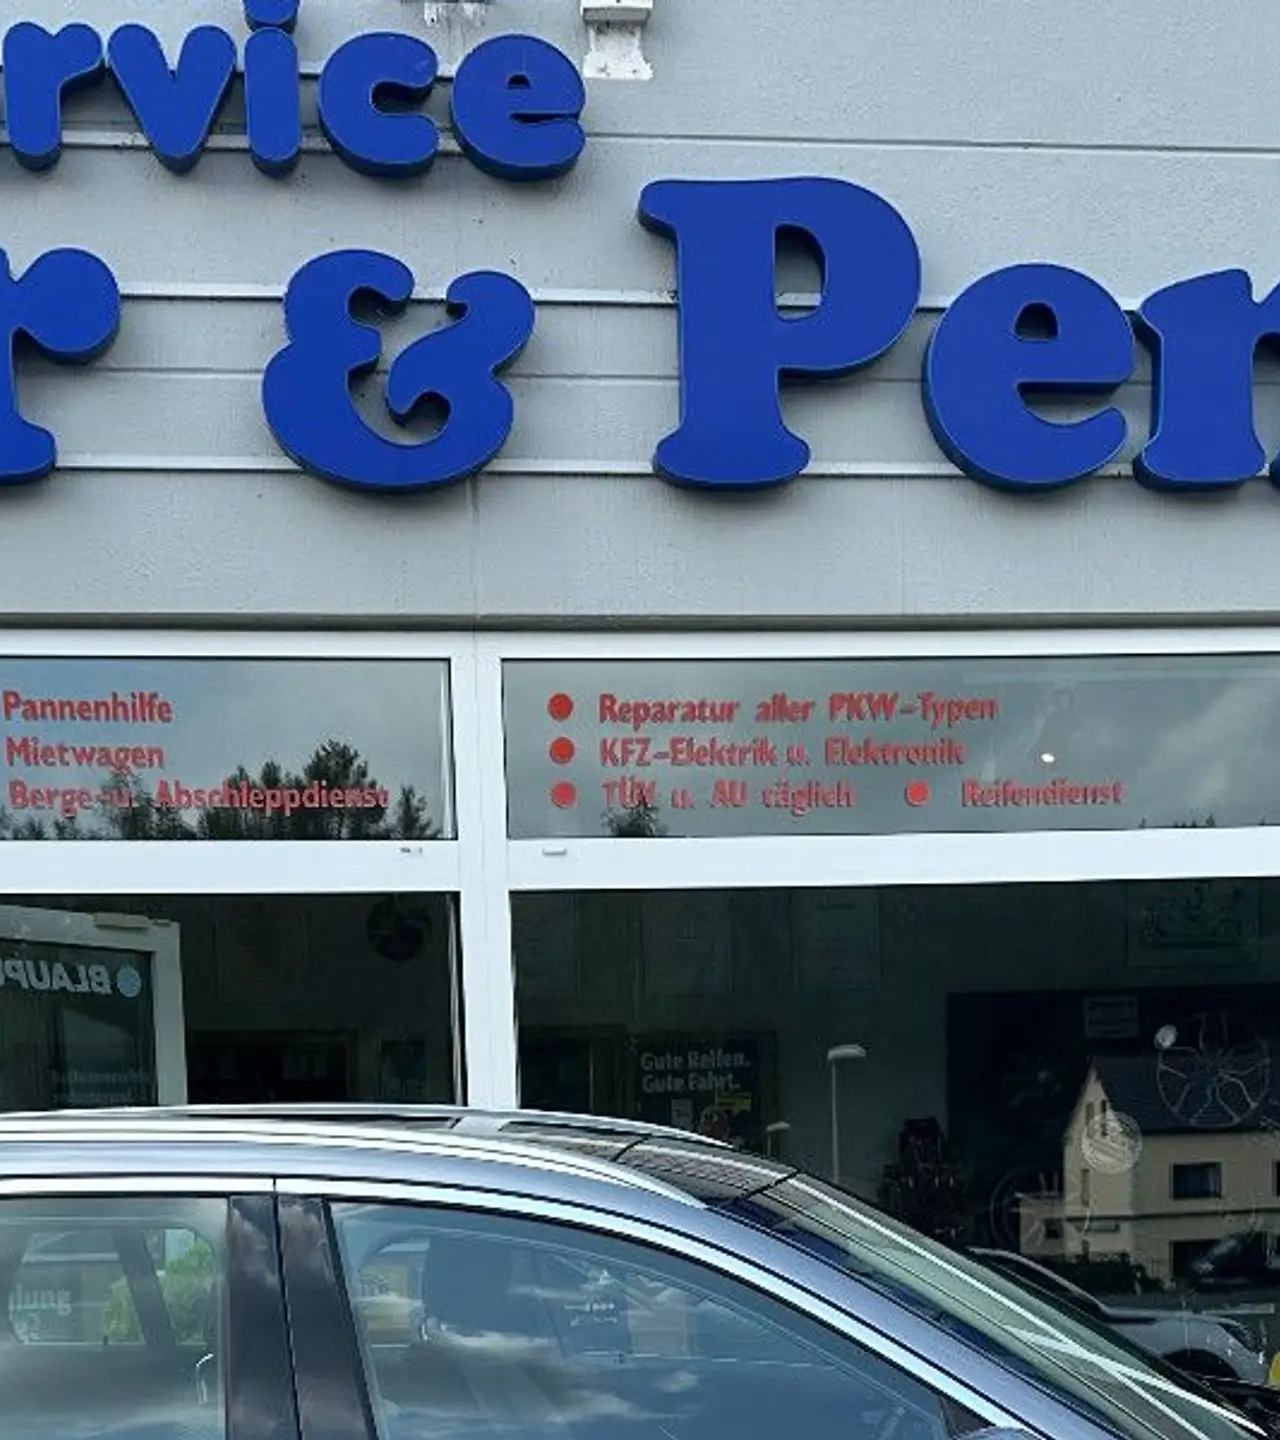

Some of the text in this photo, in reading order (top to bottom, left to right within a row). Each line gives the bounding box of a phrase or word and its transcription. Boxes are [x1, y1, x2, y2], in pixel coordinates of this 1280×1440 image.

[260, 248, 538, 494] &
[2, 690, 173, 723] Pannenhilfe
[599, 691, 1001, 731] Reparatur aller PKW-Typen
[5, 736, 165, 776] Mietwagen
[599, 734, 778, 767] KFZ-Elektrik
[825, 734, 968, 766] Elektronik
[155, 776, 390, 815] Abschleppdienst
[602, 774, 658, 809] TÜV
[710, 778, 752, 809] AU
[962, 776, 1128, 808] Reifendienst
